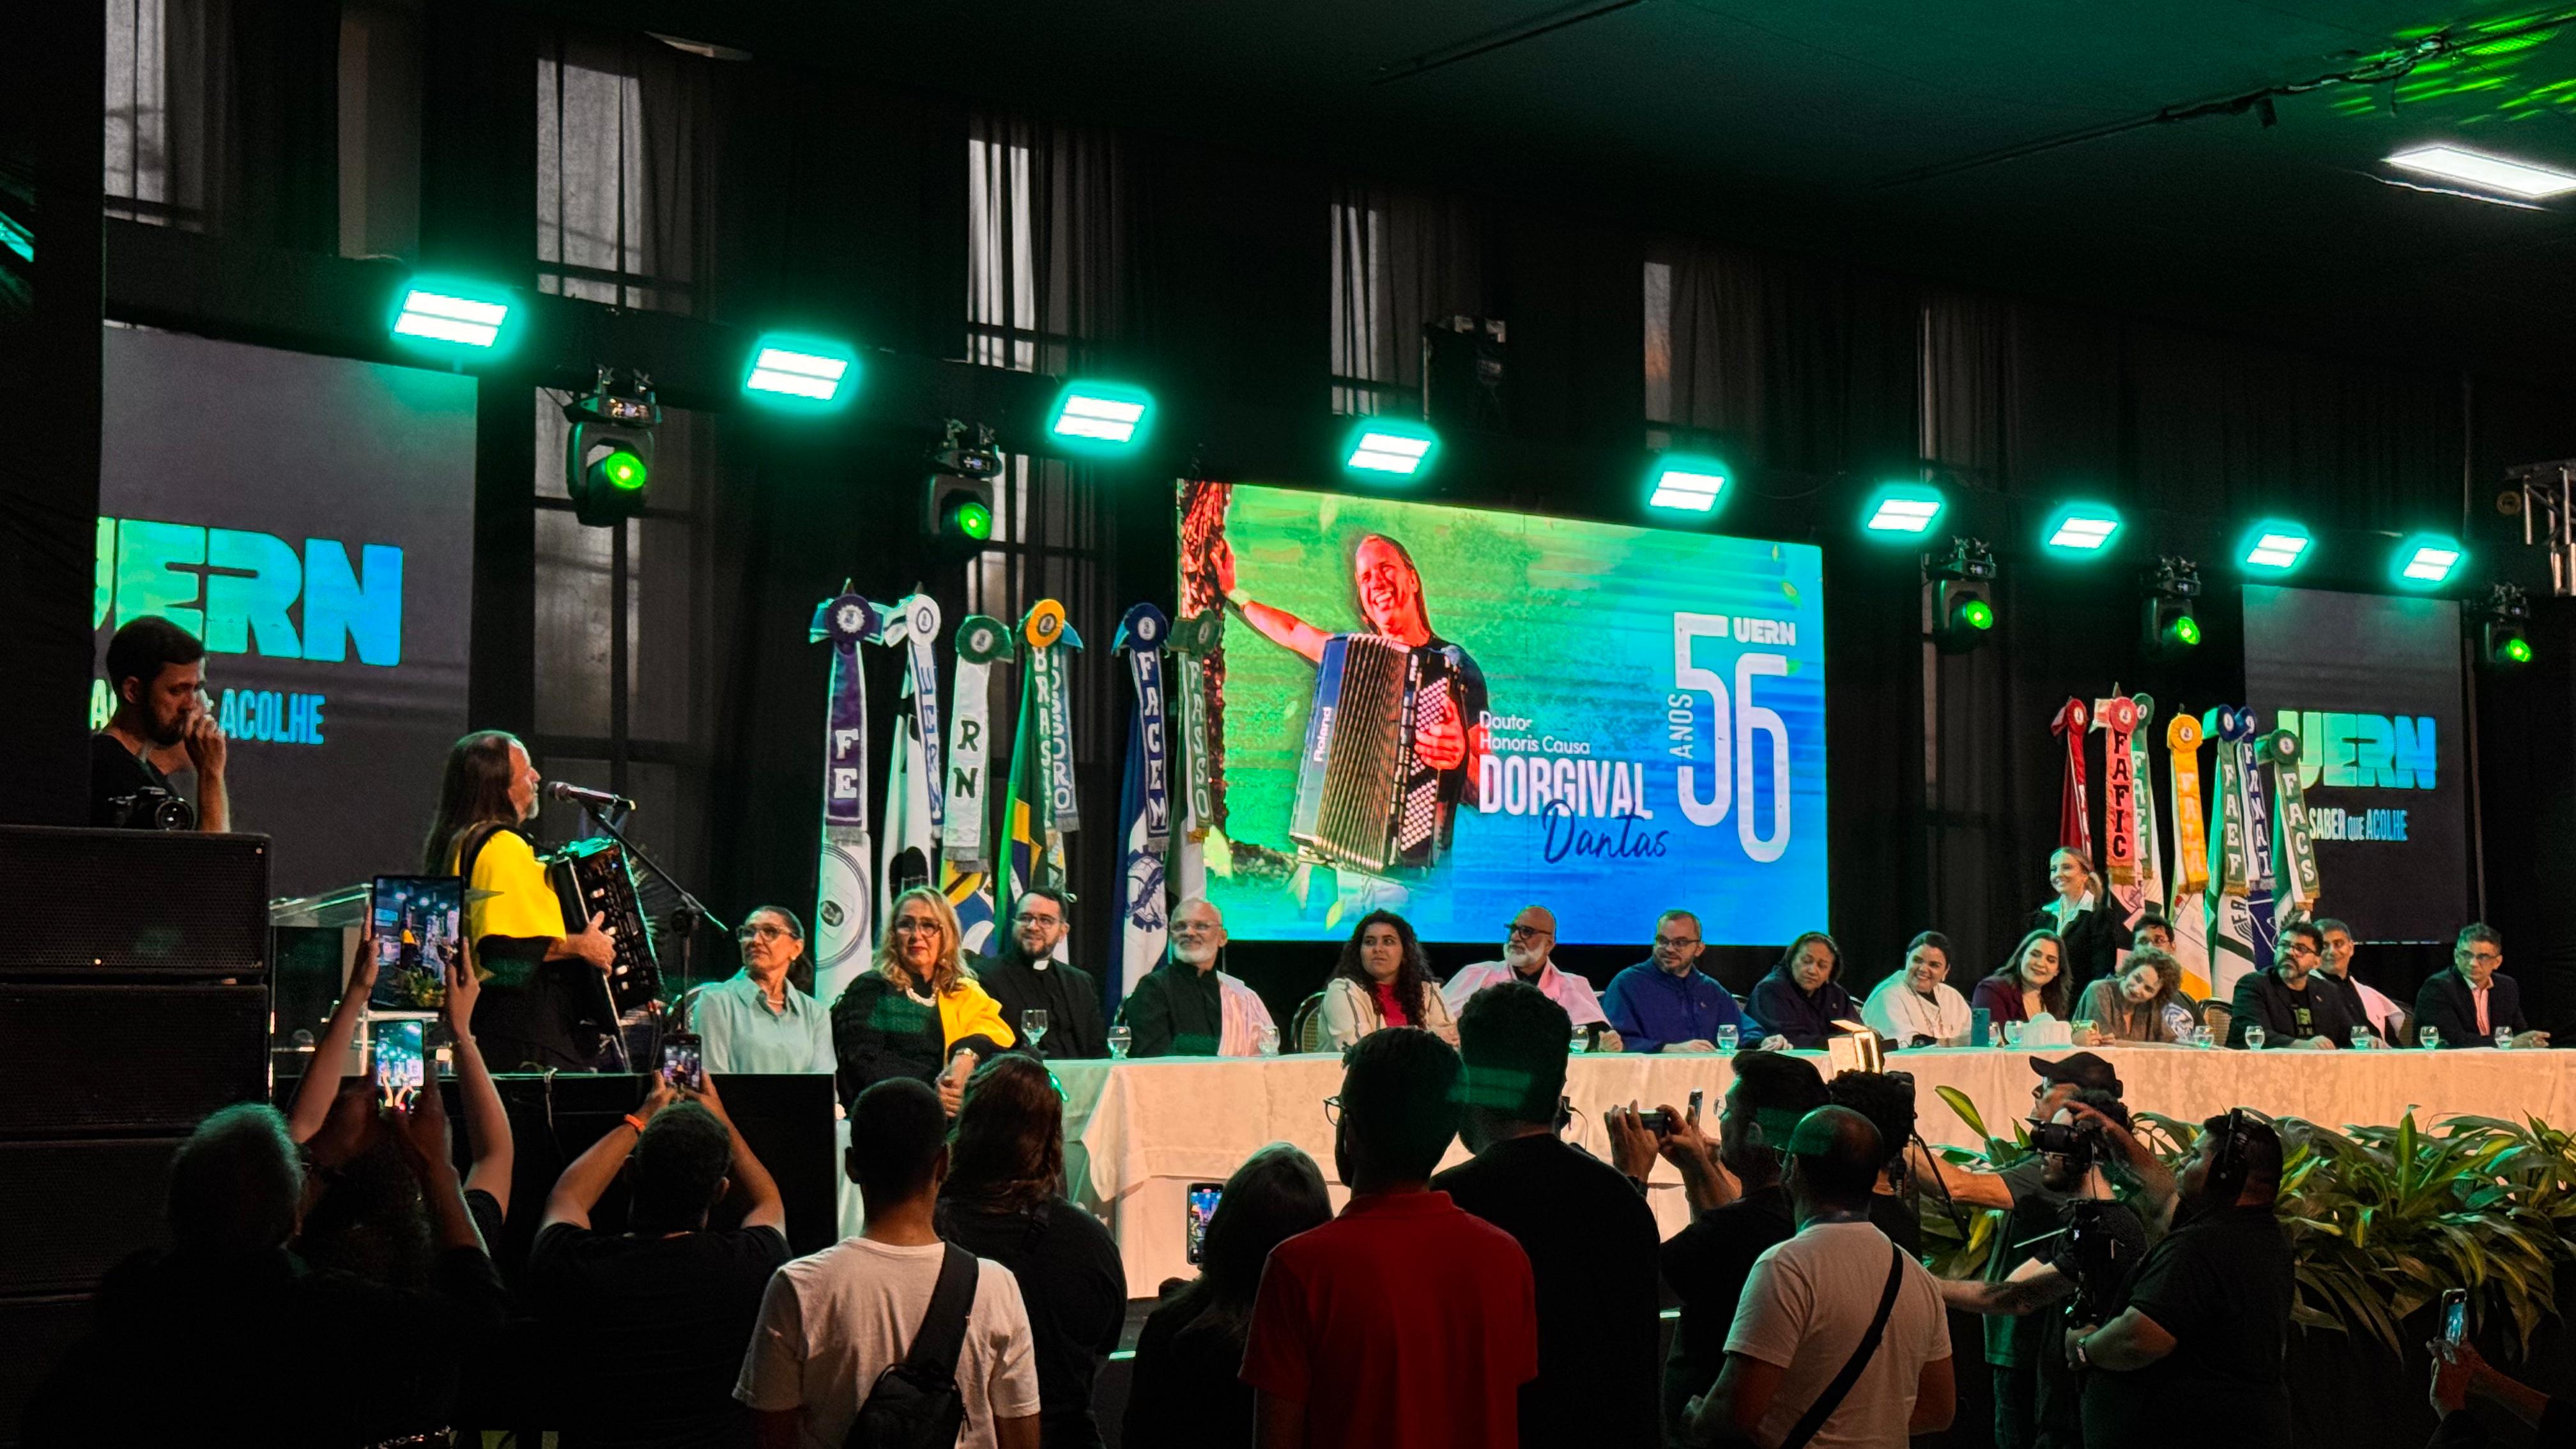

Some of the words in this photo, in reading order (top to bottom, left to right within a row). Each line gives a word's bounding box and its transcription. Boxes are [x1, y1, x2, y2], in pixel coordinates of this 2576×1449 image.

[95, 516, 403, 666] ERN
[1733, 617, 1796, 646] UERN
[219, 688, 325, 744] ACOLHE
[921, 667, 942, 812] UERN
[1032, 647, 1052, 829] BRASIL
[1137, 651, 1167, 827] FACEM
[1188, 661, 1209, 818] FASSO
[1314, 706, 1332, 762] Roland
[1479, 710, 1533, 732] Doutor
[1479, 732, 1539, 752] Honoris
[1542, 736, 1591, 755] Causa
[1667, 694, 1694, 759] ANOS
[1674, 612, 1790, 863] 56
[2278, 710, 2435, 790] UERN
[834, 728, 859, 799] FE
[953, 720, 981, 798] RN
[1479, 755, 1653, 820] DORGIVAL
[2112, 730, 2129, 857] FAFIC
[1542, 799, 1669, 864] Dantas
[2224, 764, 2241, 875] FAEF
[2244, 742, 2271, 877] FANAT
[2282, 772, 2315, 882] FACS
[2308, 808, 2346, 840] SABER
[2366, 808, 2408, 841] ACOLHE
